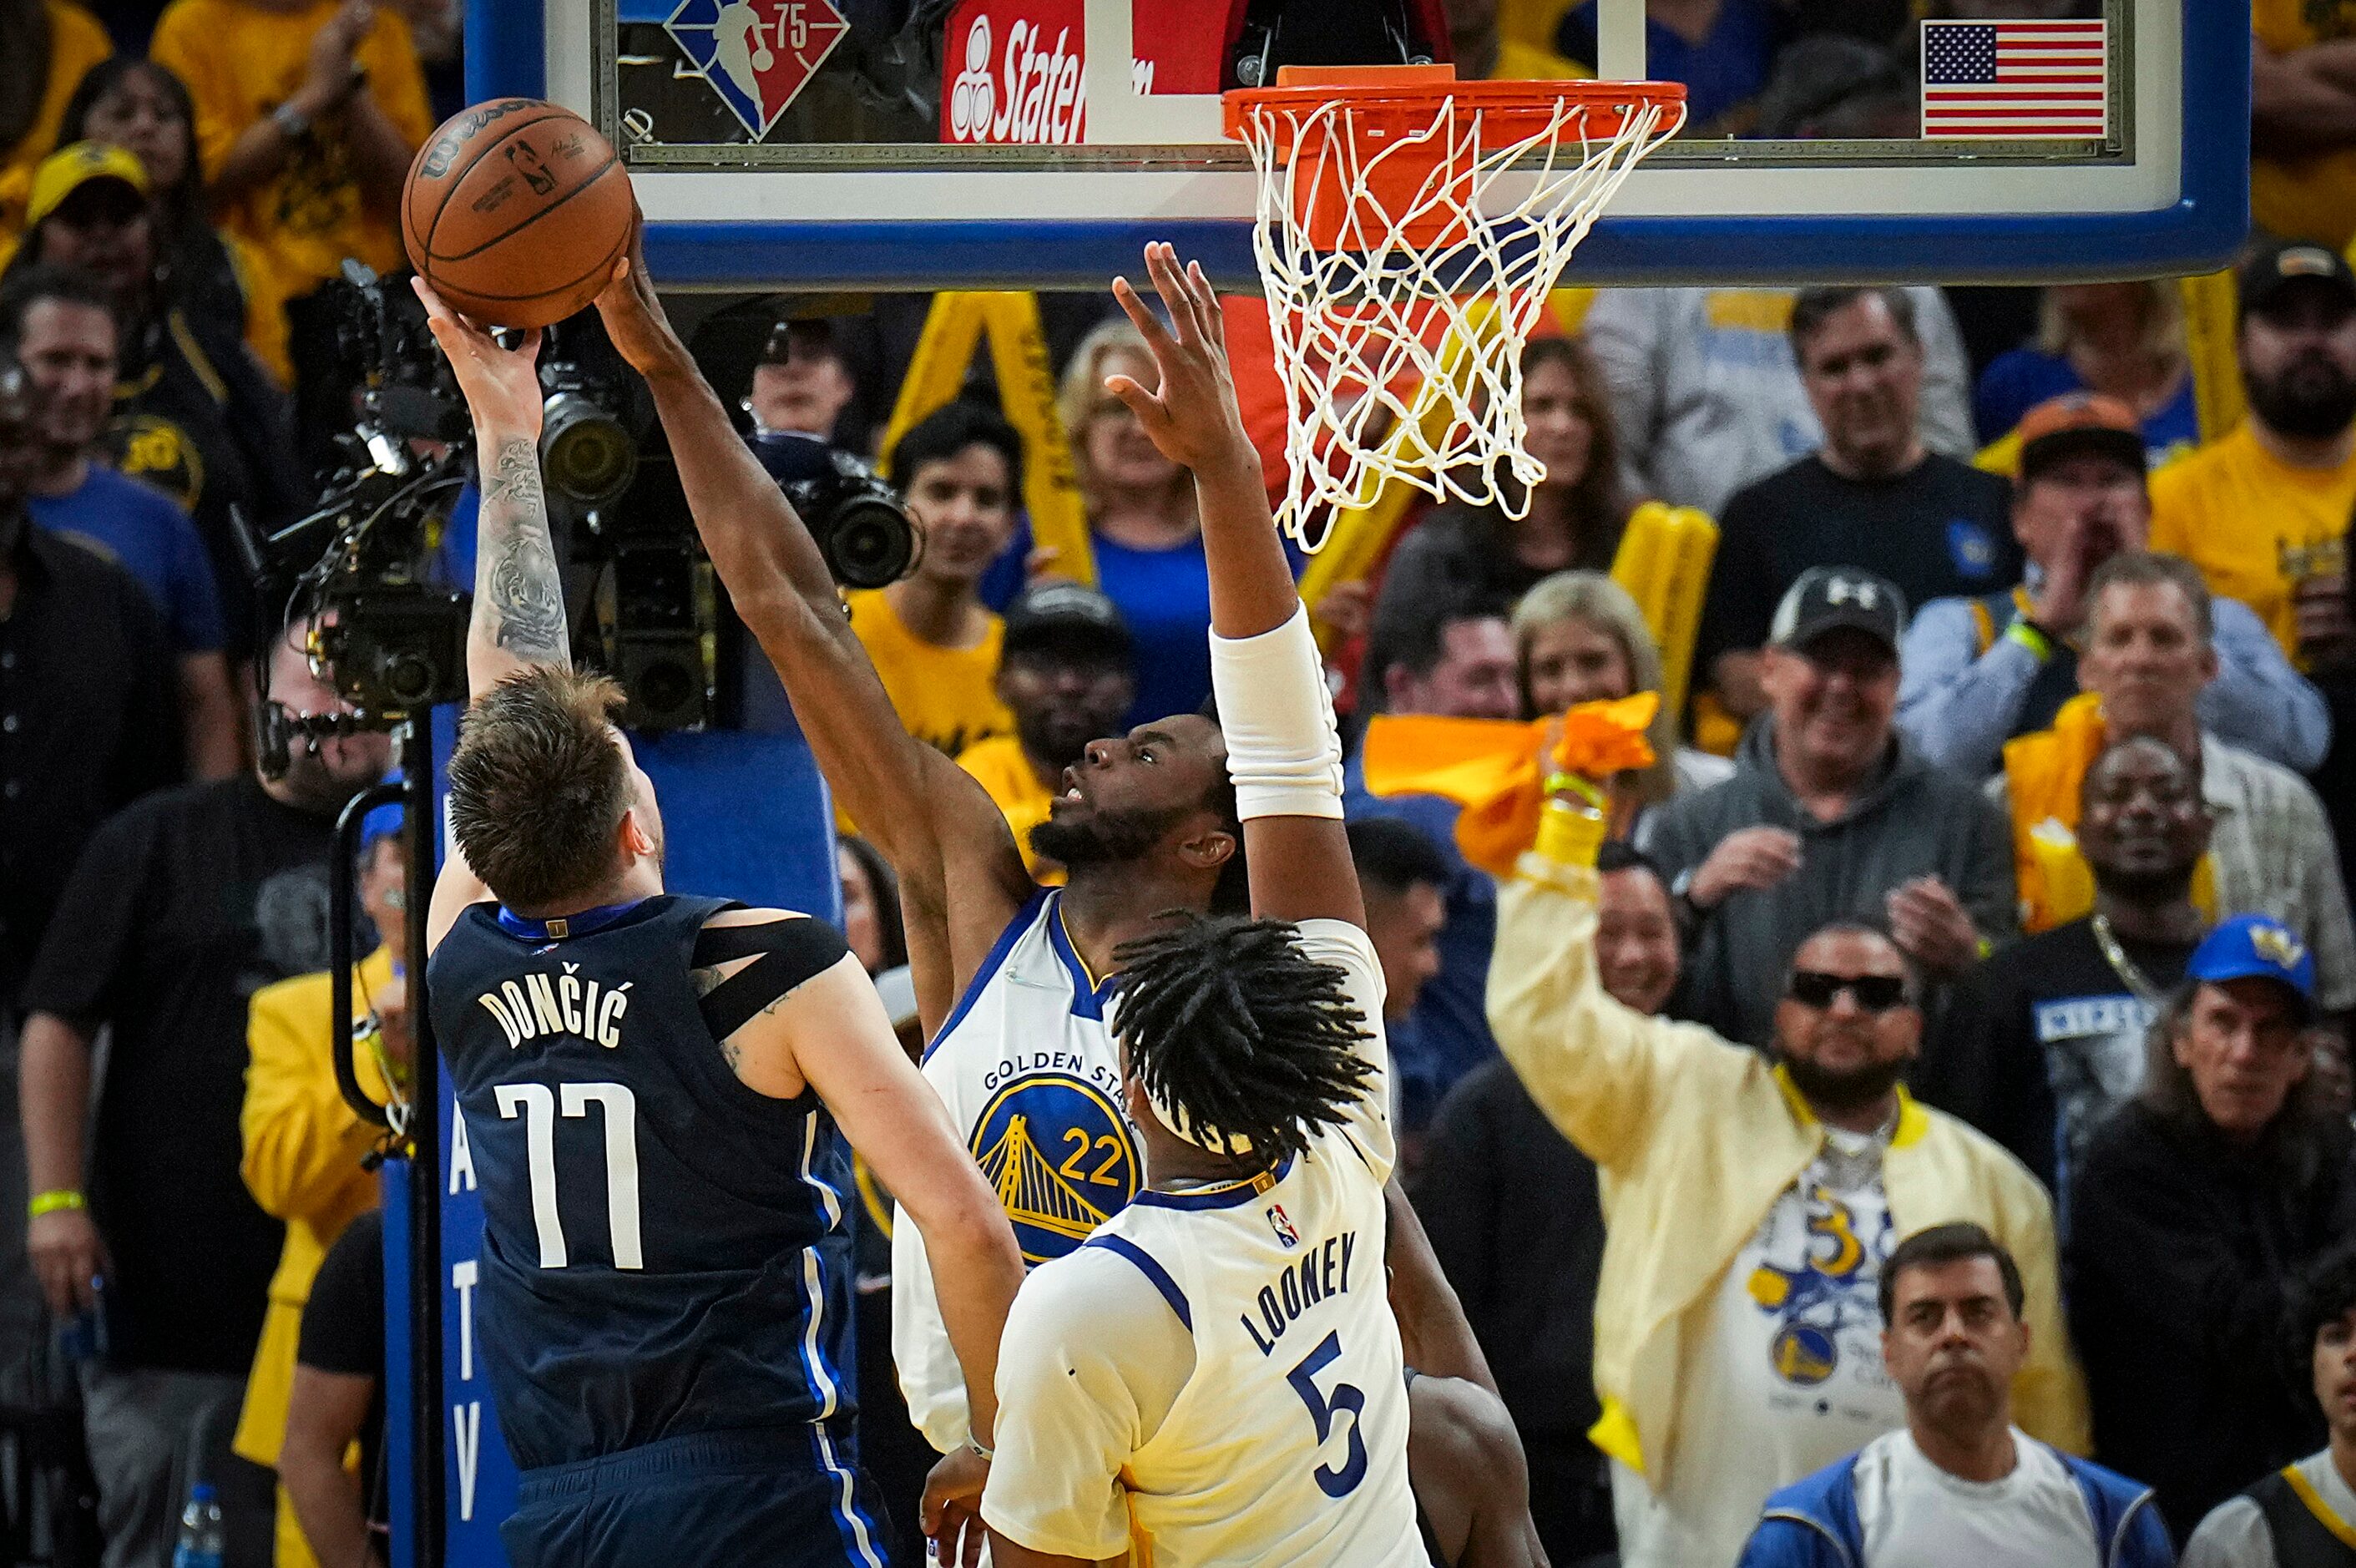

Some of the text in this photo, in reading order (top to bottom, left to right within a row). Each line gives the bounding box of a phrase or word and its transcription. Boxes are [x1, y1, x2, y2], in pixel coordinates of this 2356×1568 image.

[773, 3, 806, 49] 75
[993, 18, 1080, 144] State
[478, 961, 634, 1050] DONČIĆ
[984, 1052, 1083, 1090] GOLDEN
[493, 1083, 643, 1269] 77
[1059, 1127, 1123, 1187] 22
[1241, 1231, 1356, 1357] LOONEY
[1286, 1328, 1368, 1498] 5
